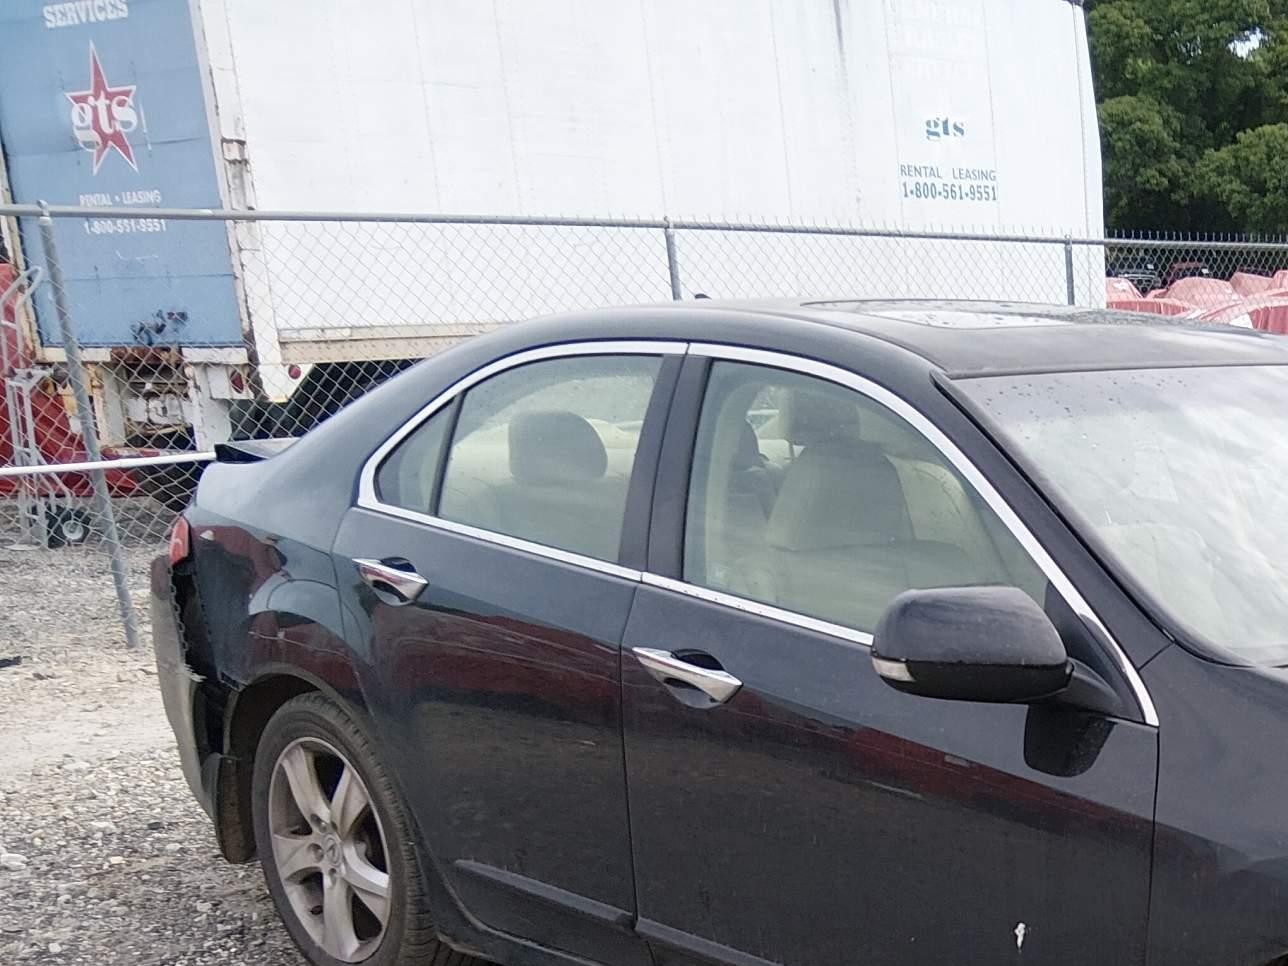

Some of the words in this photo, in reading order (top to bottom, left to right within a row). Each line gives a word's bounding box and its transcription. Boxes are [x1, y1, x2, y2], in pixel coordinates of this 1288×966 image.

[43, 0, 128, 28] SERVICES
[925, 116, 965, 141] gts
[900, 164, 943, 180] RENTAL
[952, 167, 997, 181] LEASING
[121, 190, 162, 204] LEASING
